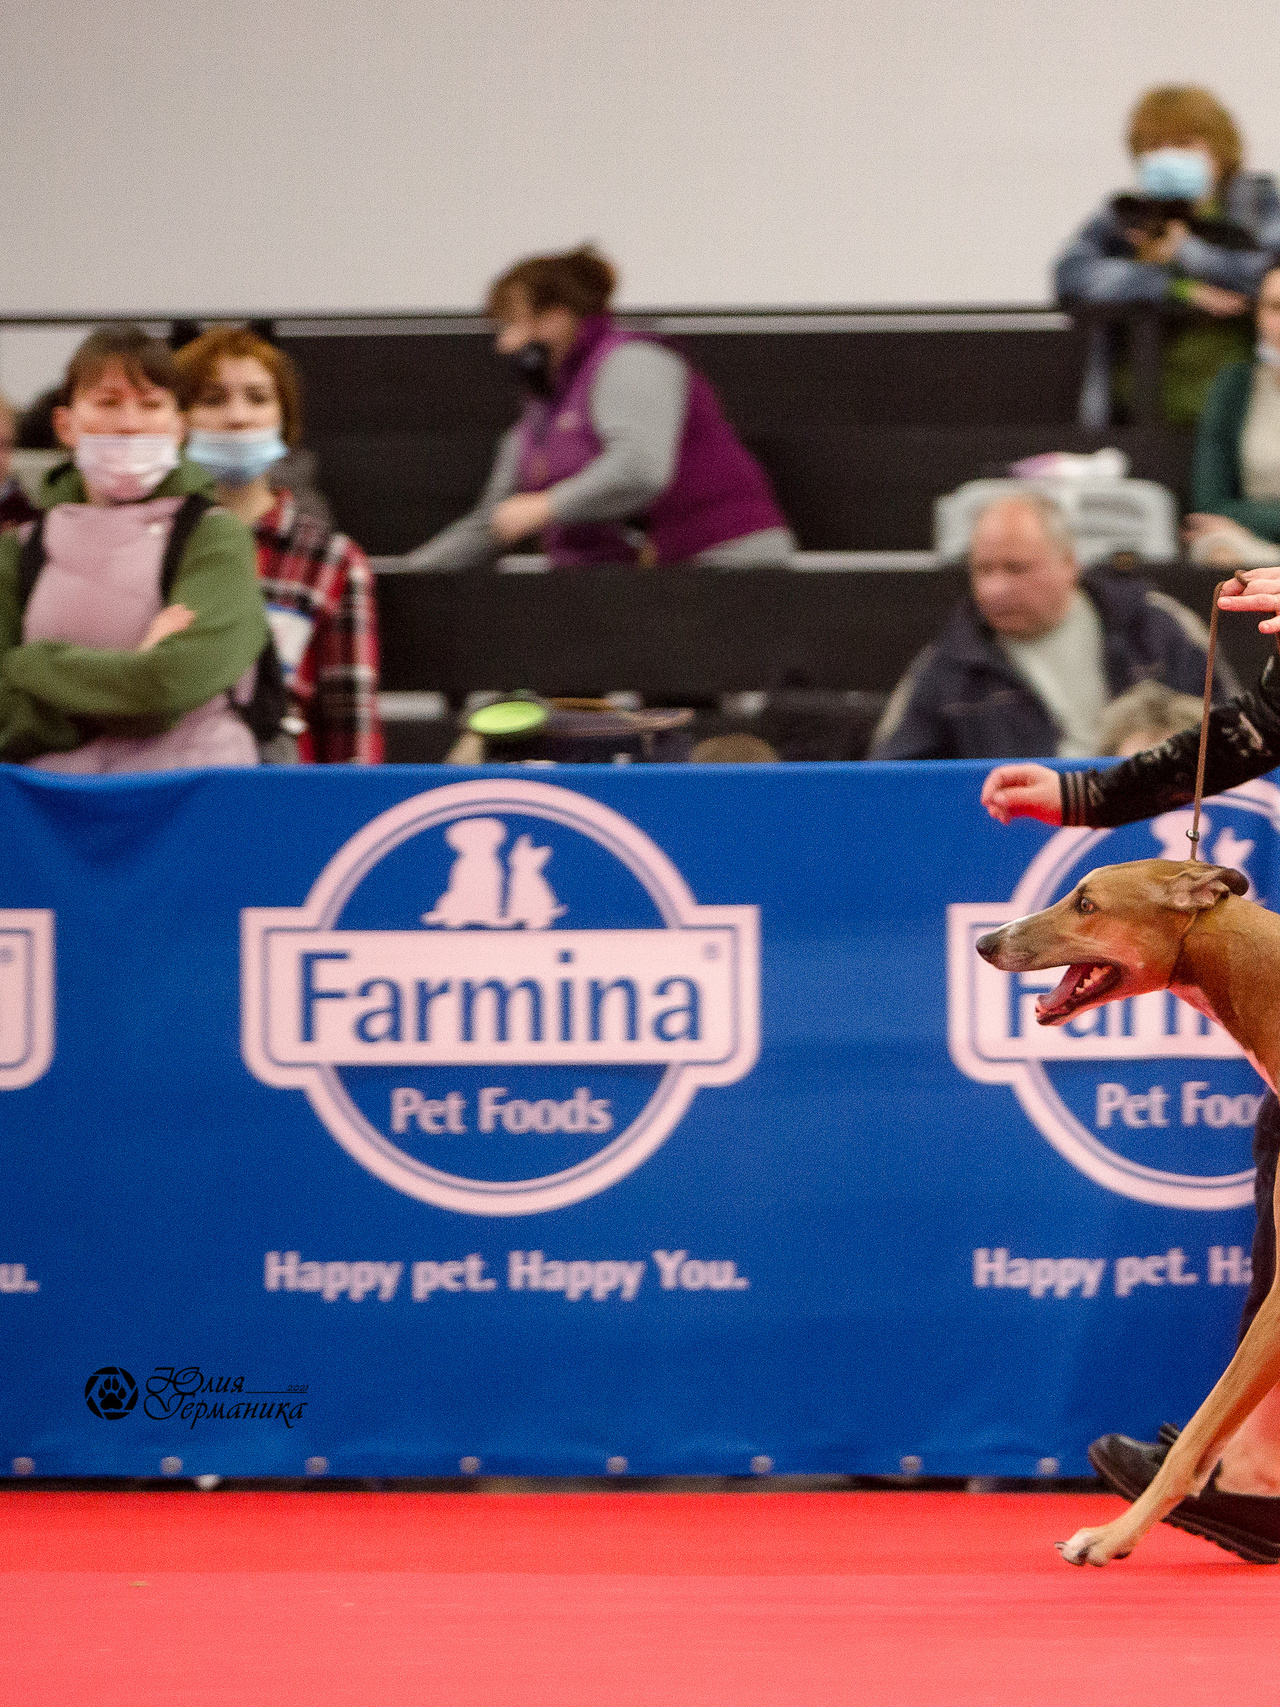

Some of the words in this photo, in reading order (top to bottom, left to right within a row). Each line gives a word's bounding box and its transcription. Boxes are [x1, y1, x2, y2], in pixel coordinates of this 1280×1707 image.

[300, 950, 702, 1044] Farmina
[391, 1088, 465, 1134] Pet
[480, 1088, 612, 1134] Foods
[1096, 1082, 1169, 1129] Pet
[1181, 1080, 1259, 1129] Foo
[264, 1251, 400, 1303] Happy
[411, 1253, 497, 1301] pet.
[508, 1250, 644, 1302] Happy
[653, 1249, 749, 1293] You.
[973, 1247, 1106, 1298] Happy
[1114, 1247, 1197, 1296] pet.
